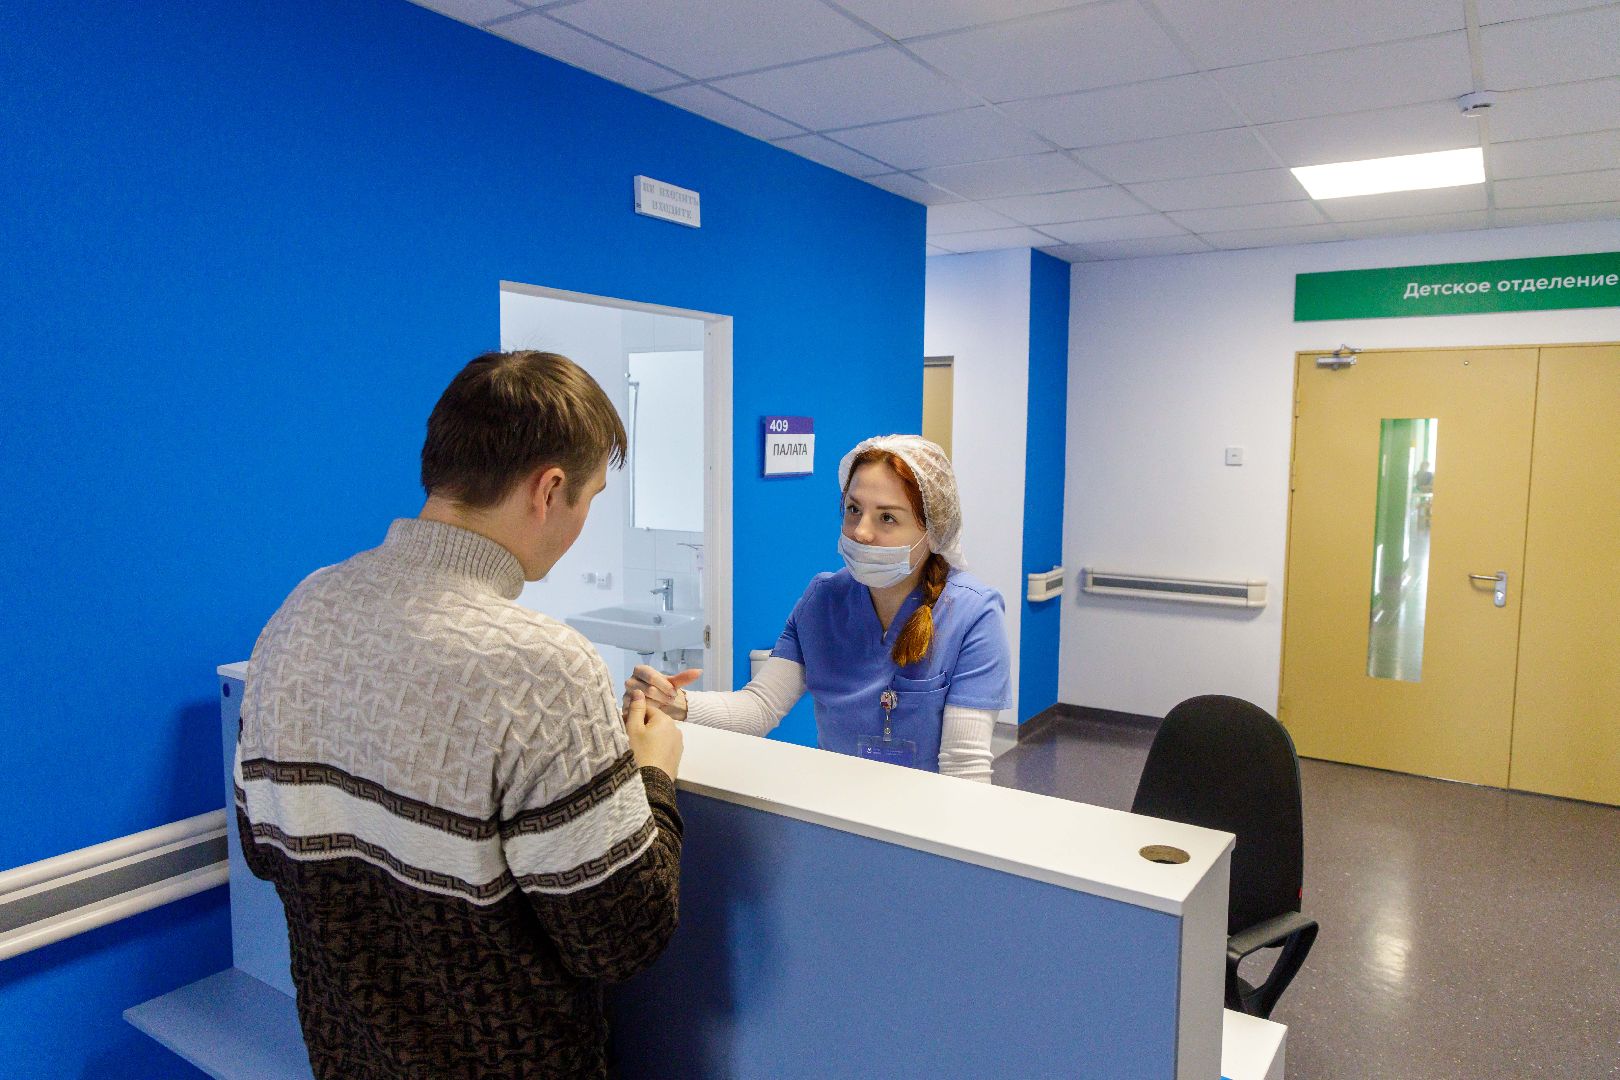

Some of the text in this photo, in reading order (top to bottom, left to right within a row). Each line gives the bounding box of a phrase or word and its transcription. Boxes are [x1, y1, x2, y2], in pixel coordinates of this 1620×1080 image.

[1403, 273, 1619, 300] Детское отделение
[769, 419, 789, 432] 409
[773, 443, 808, 456] ПАЛАТА
